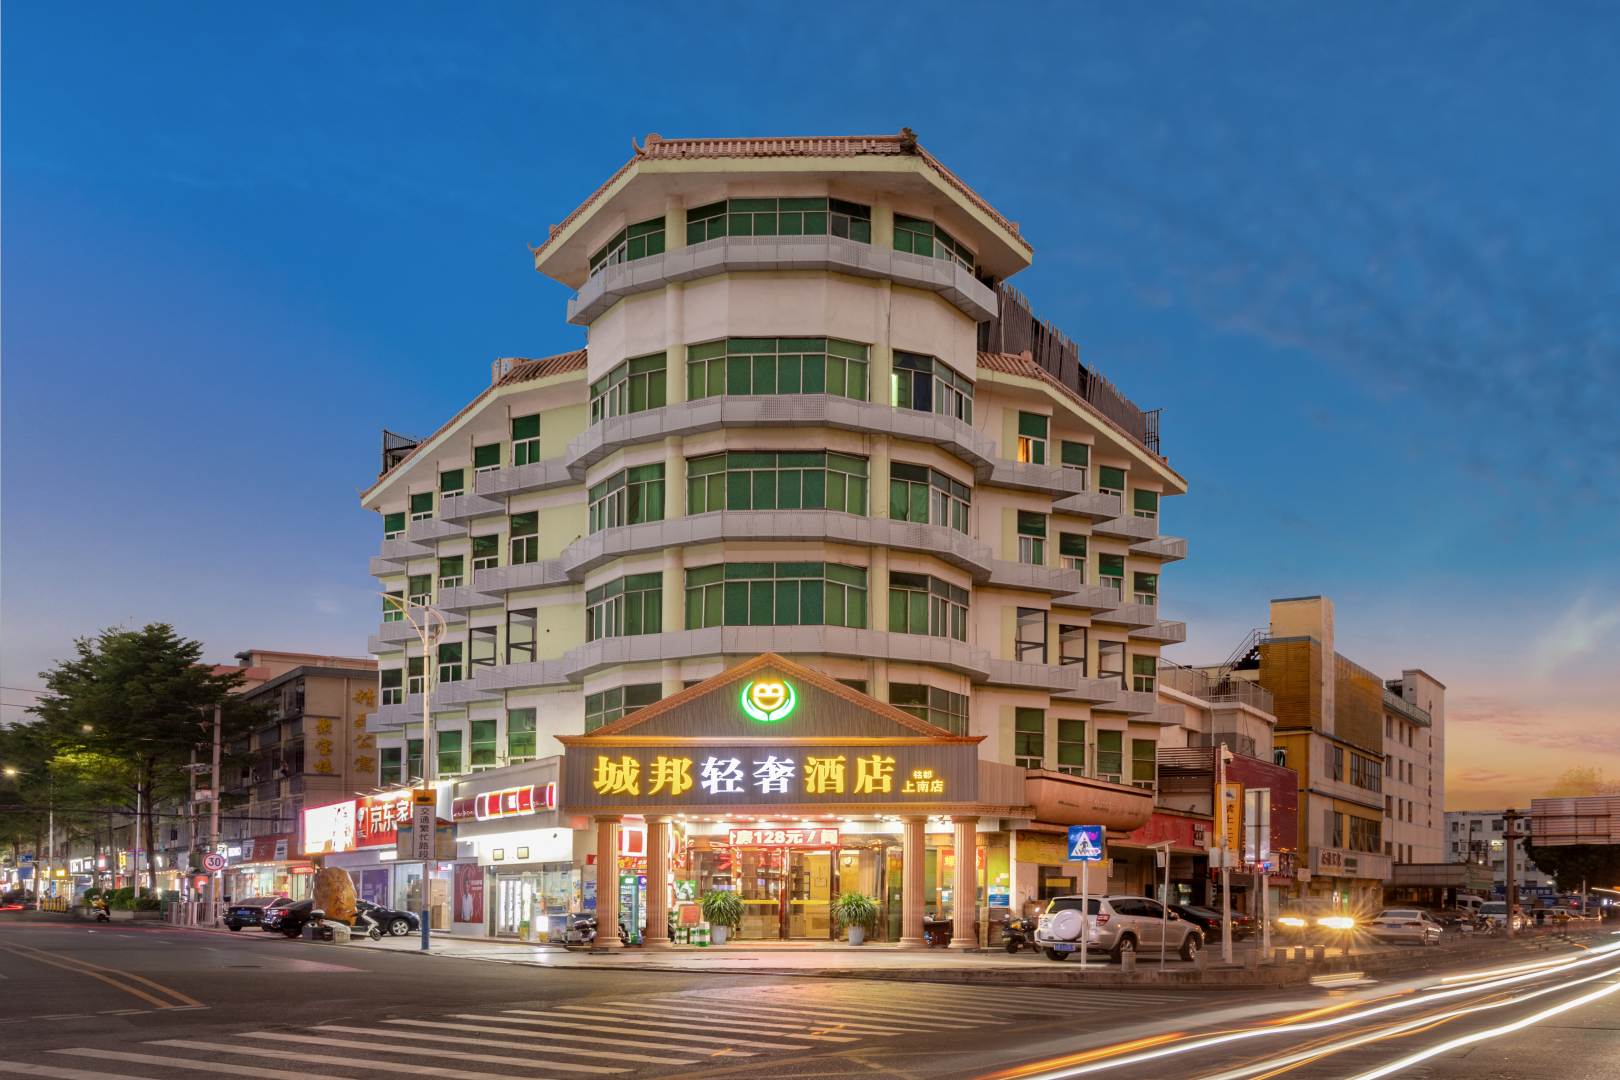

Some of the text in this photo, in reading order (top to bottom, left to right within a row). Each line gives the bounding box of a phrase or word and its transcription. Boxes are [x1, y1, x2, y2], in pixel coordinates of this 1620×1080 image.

[593, 754, 896, 796] 城邦轻奢酒店
[902, 781, 944, 793] 上南店
[370, 799, 413, 834] 京东家
[418, 807, 430, 859] 交通繁忙路段
[208, 857, 221, 867] 30
